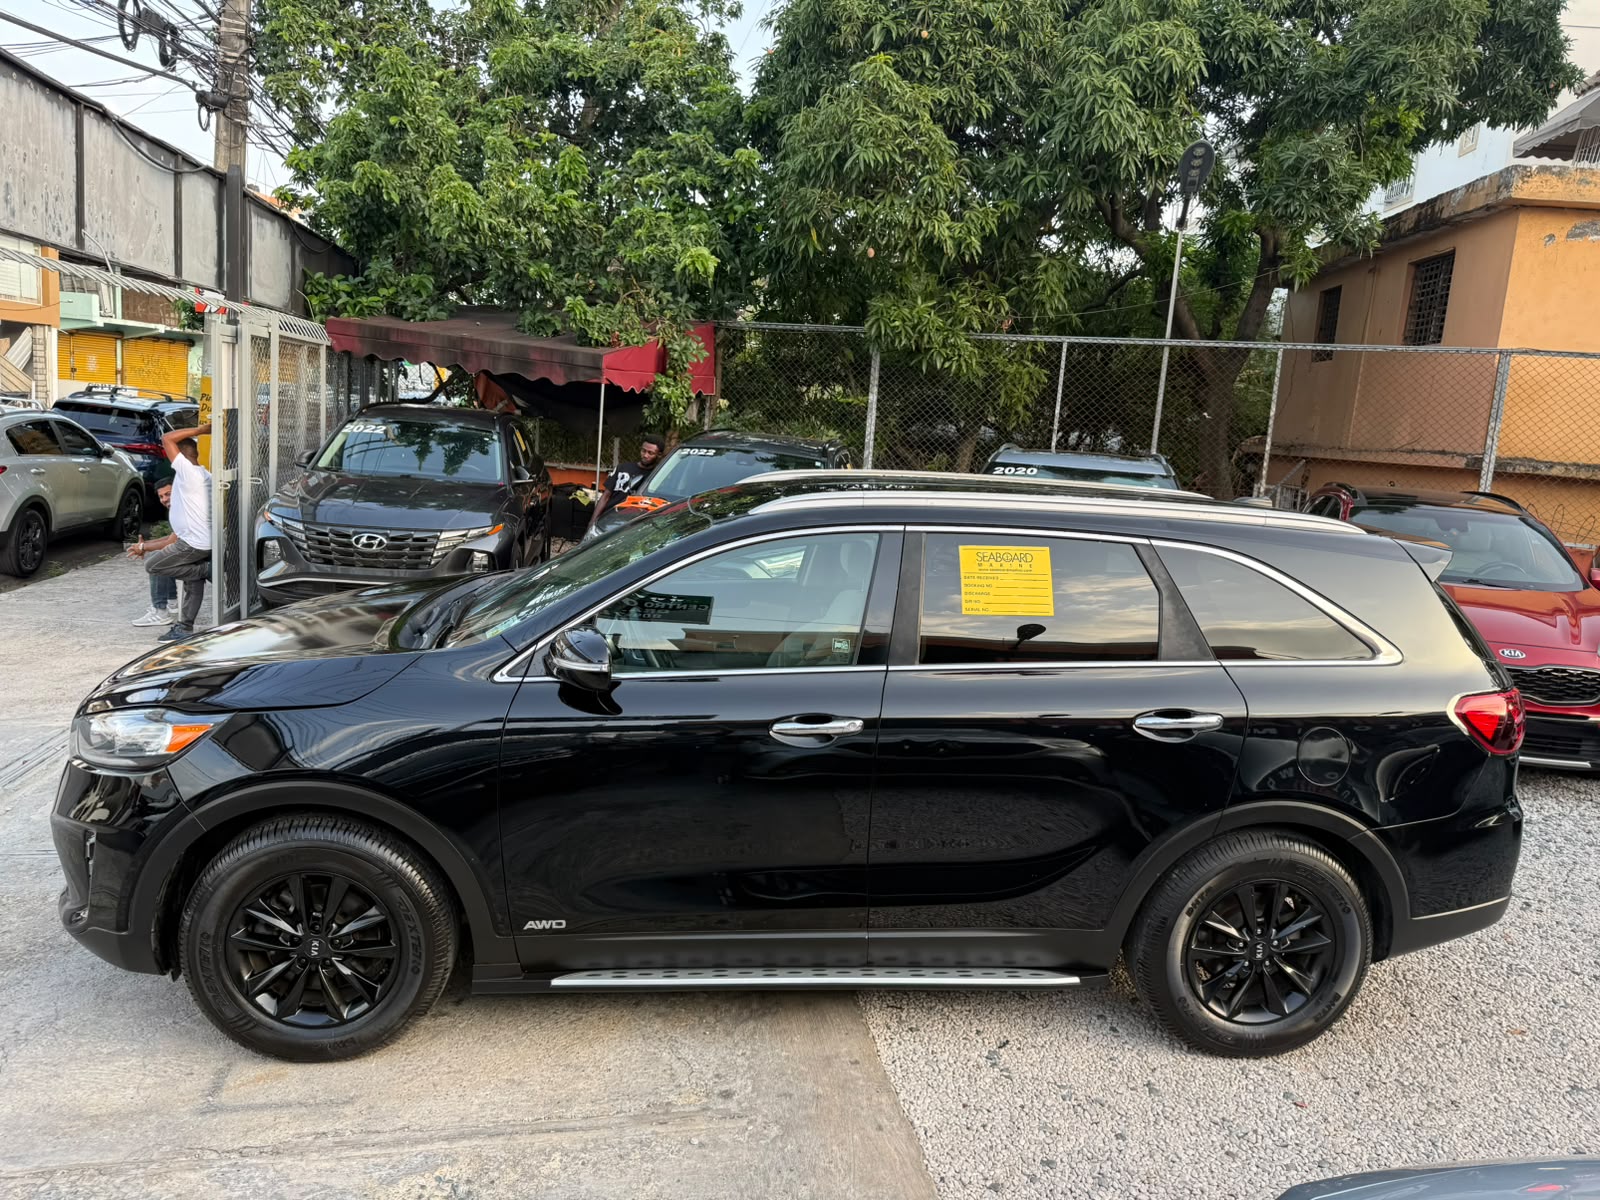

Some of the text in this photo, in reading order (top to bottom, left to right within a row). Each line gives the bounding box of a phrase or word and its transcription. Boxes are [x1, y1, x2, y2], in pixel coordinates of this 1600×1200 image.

[341, 424, 387, 434] 2022
[680, 448, 716, 456] 2022
[992, 466, 1038, 475] 2020
[976, 552, 1034, 563] SEABOARD
[1503, 649, 1523, 657] KIA
[523, 919, 567, 930] AWD
[311, 940, 319, 956] KIA
[1255, 943, 1263, 959] KIA
